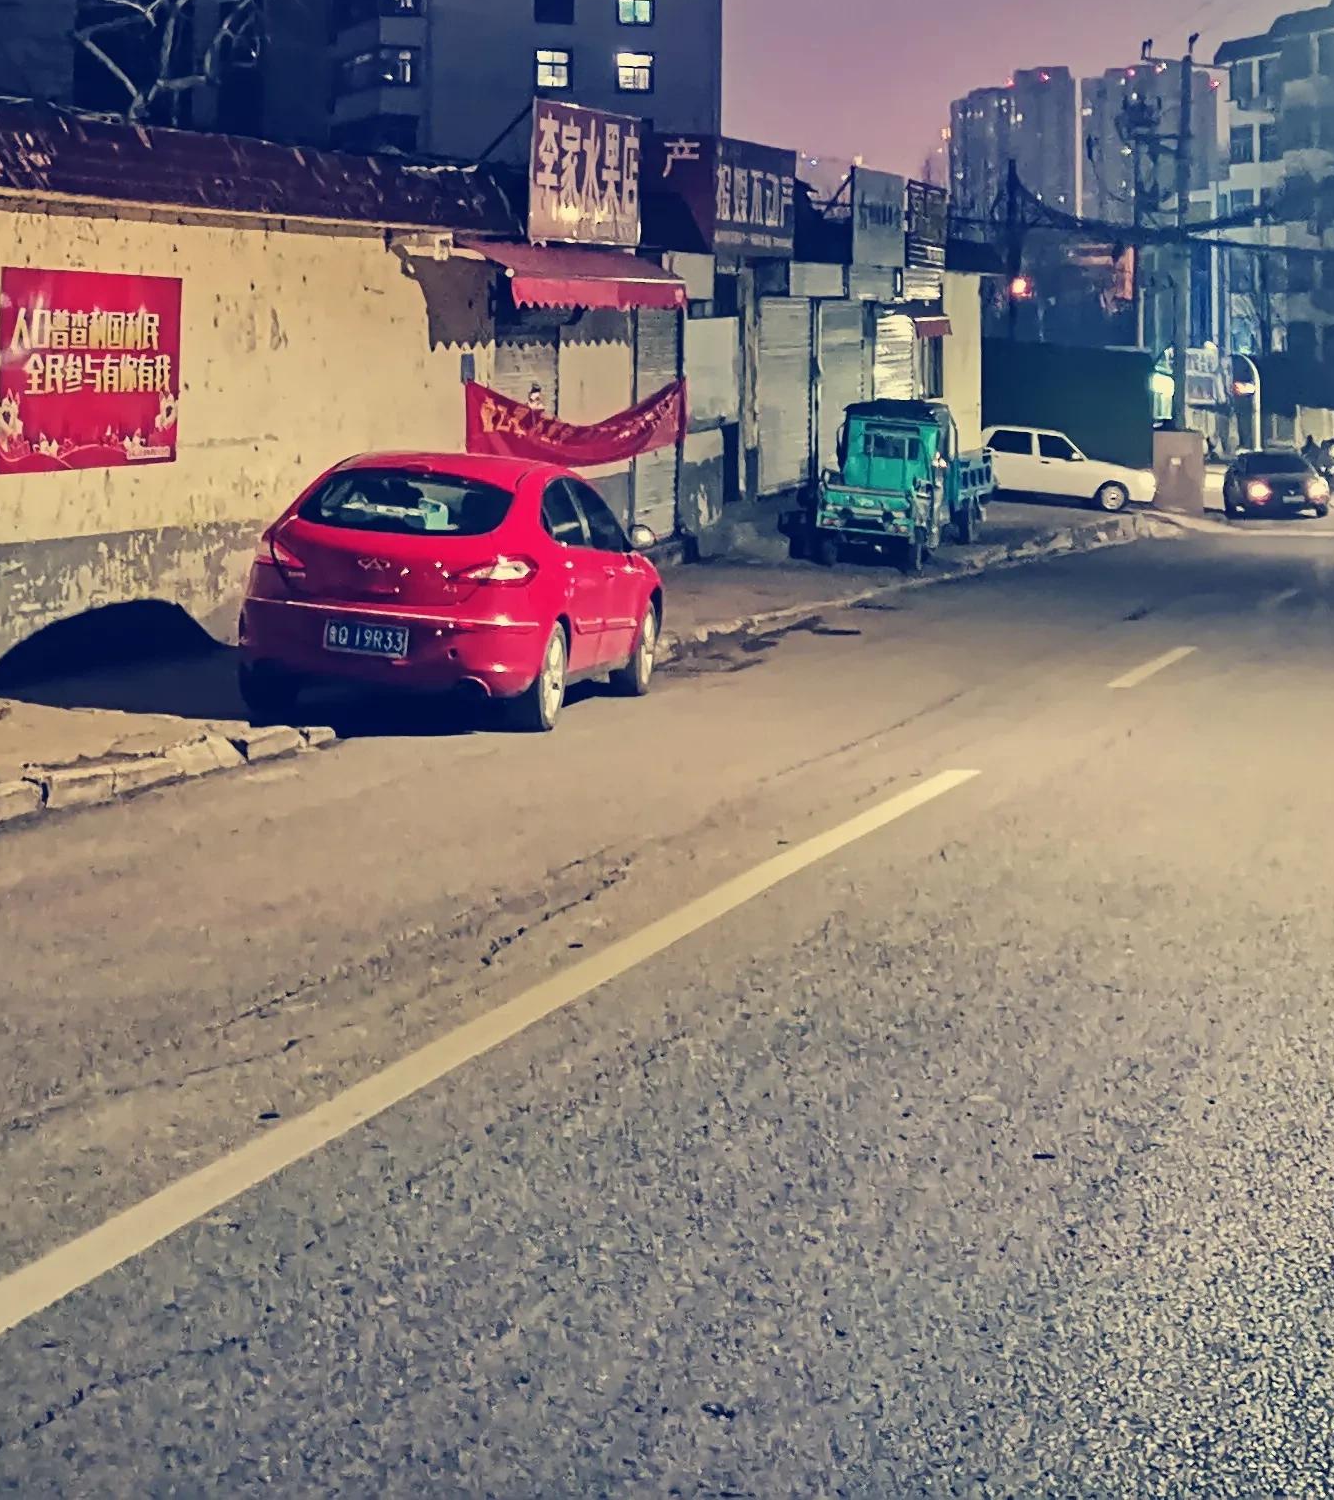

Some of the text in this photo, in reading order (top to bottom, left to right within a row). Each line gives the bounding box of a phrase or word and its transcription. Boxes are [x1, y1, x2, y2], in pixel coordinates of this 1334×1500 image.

[536, 109, 640, 222] 李家水果店
[662, 138, 701, 178] 产
[10, 306, 160, 350] 人口普查利国利民
[23, 353, 172, 395] 全民参与有你有我
